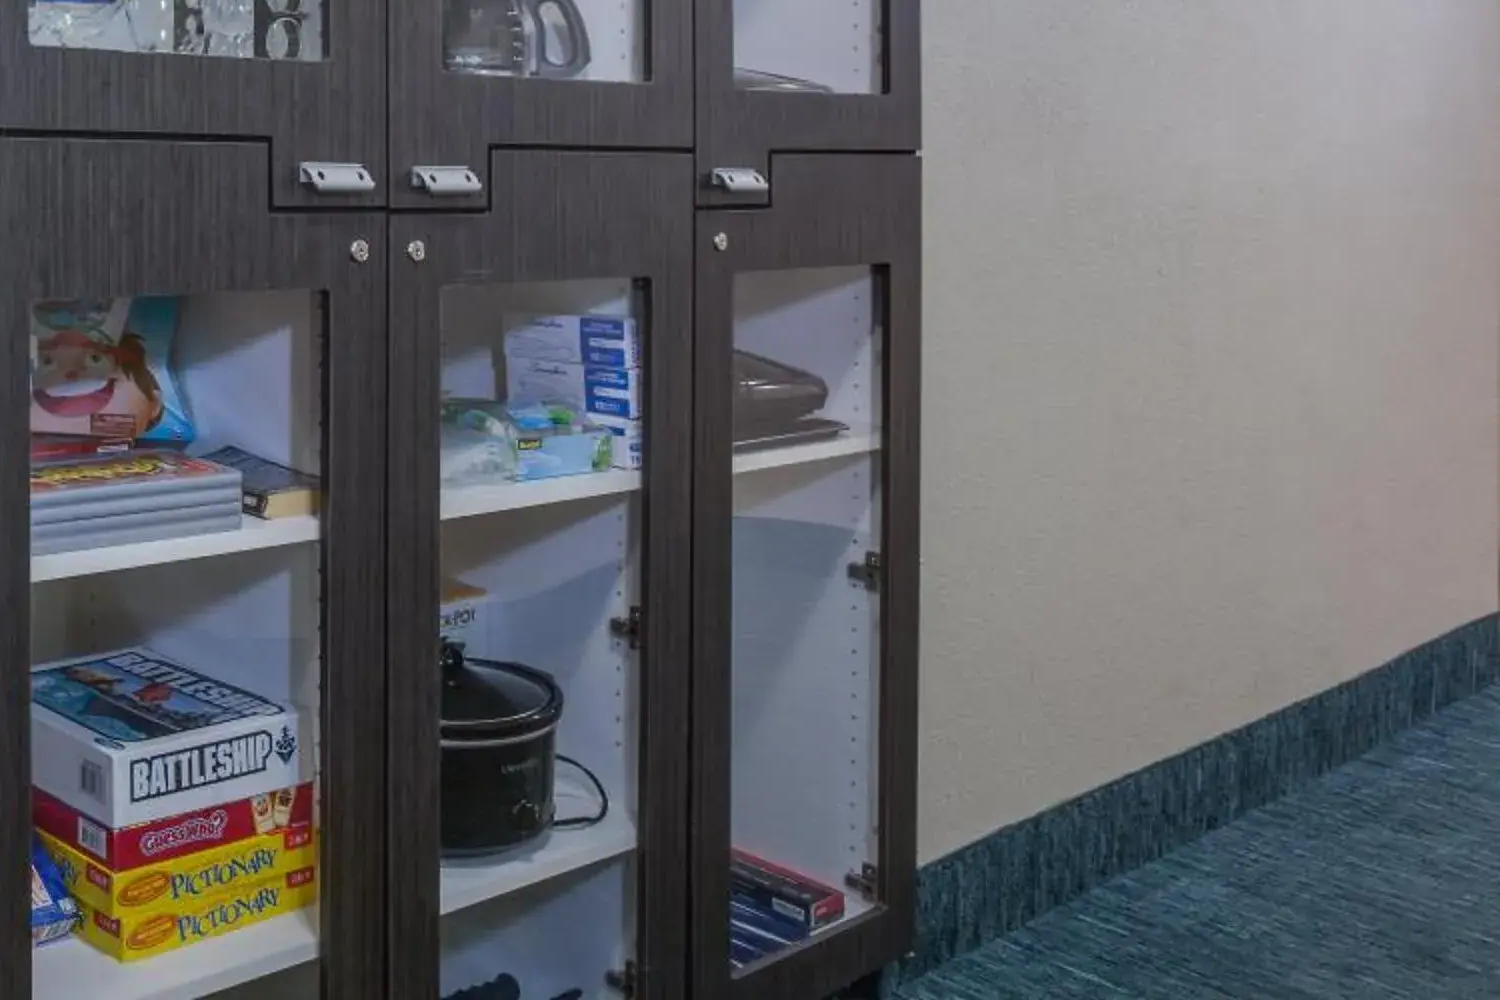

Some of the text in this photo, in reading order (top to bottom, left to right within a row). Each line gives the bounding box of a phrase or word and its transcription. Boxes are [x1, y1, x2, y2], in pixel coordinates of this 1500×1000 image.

[132, 733, 270, 800] BATTLESHIP
[169, 847, 278, 900] PICTIONARY
[177, 886, 280, 942] PICTIONARY
